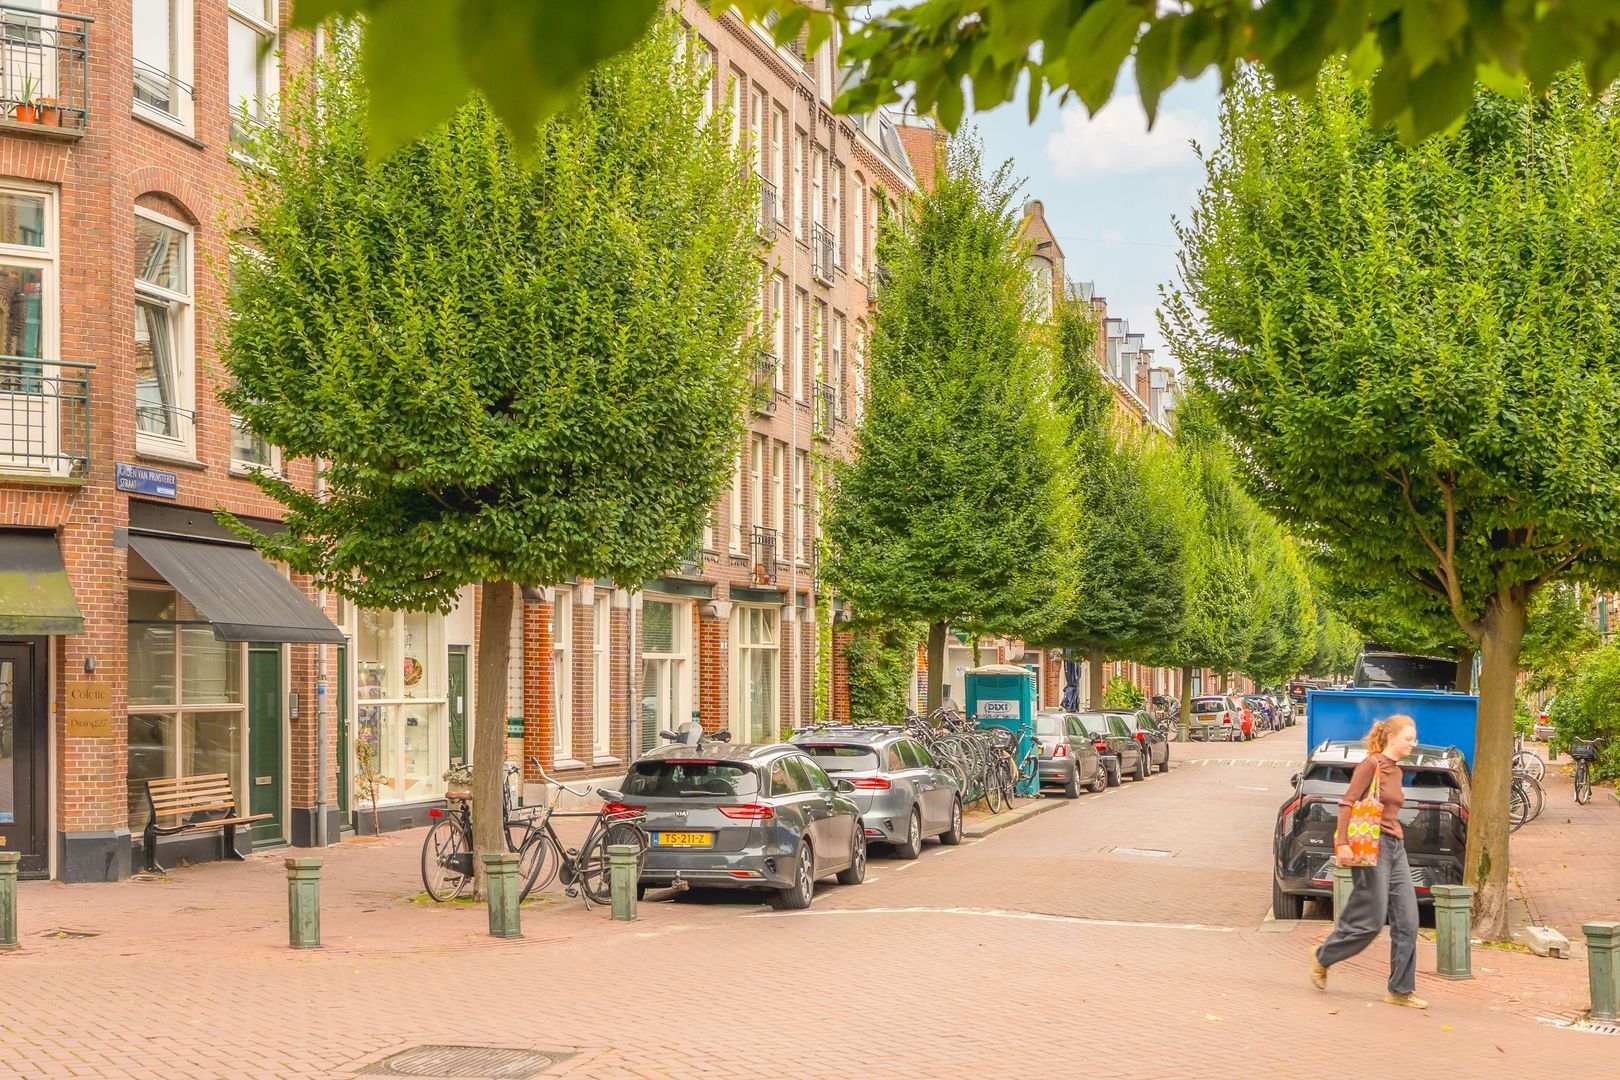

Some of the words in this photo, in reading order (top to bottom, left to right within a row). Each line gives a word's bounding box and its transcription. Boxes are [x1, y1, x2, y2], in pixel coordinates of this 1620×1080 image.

[138, 470, 148, 480] VAN
[149, 471, 175, 485] PRINSTERER
[120, 478, 137, 488] STRAAT
[72, 690, 105, 699] Colette
[665, 834, 704, 843] TS-211-Z
